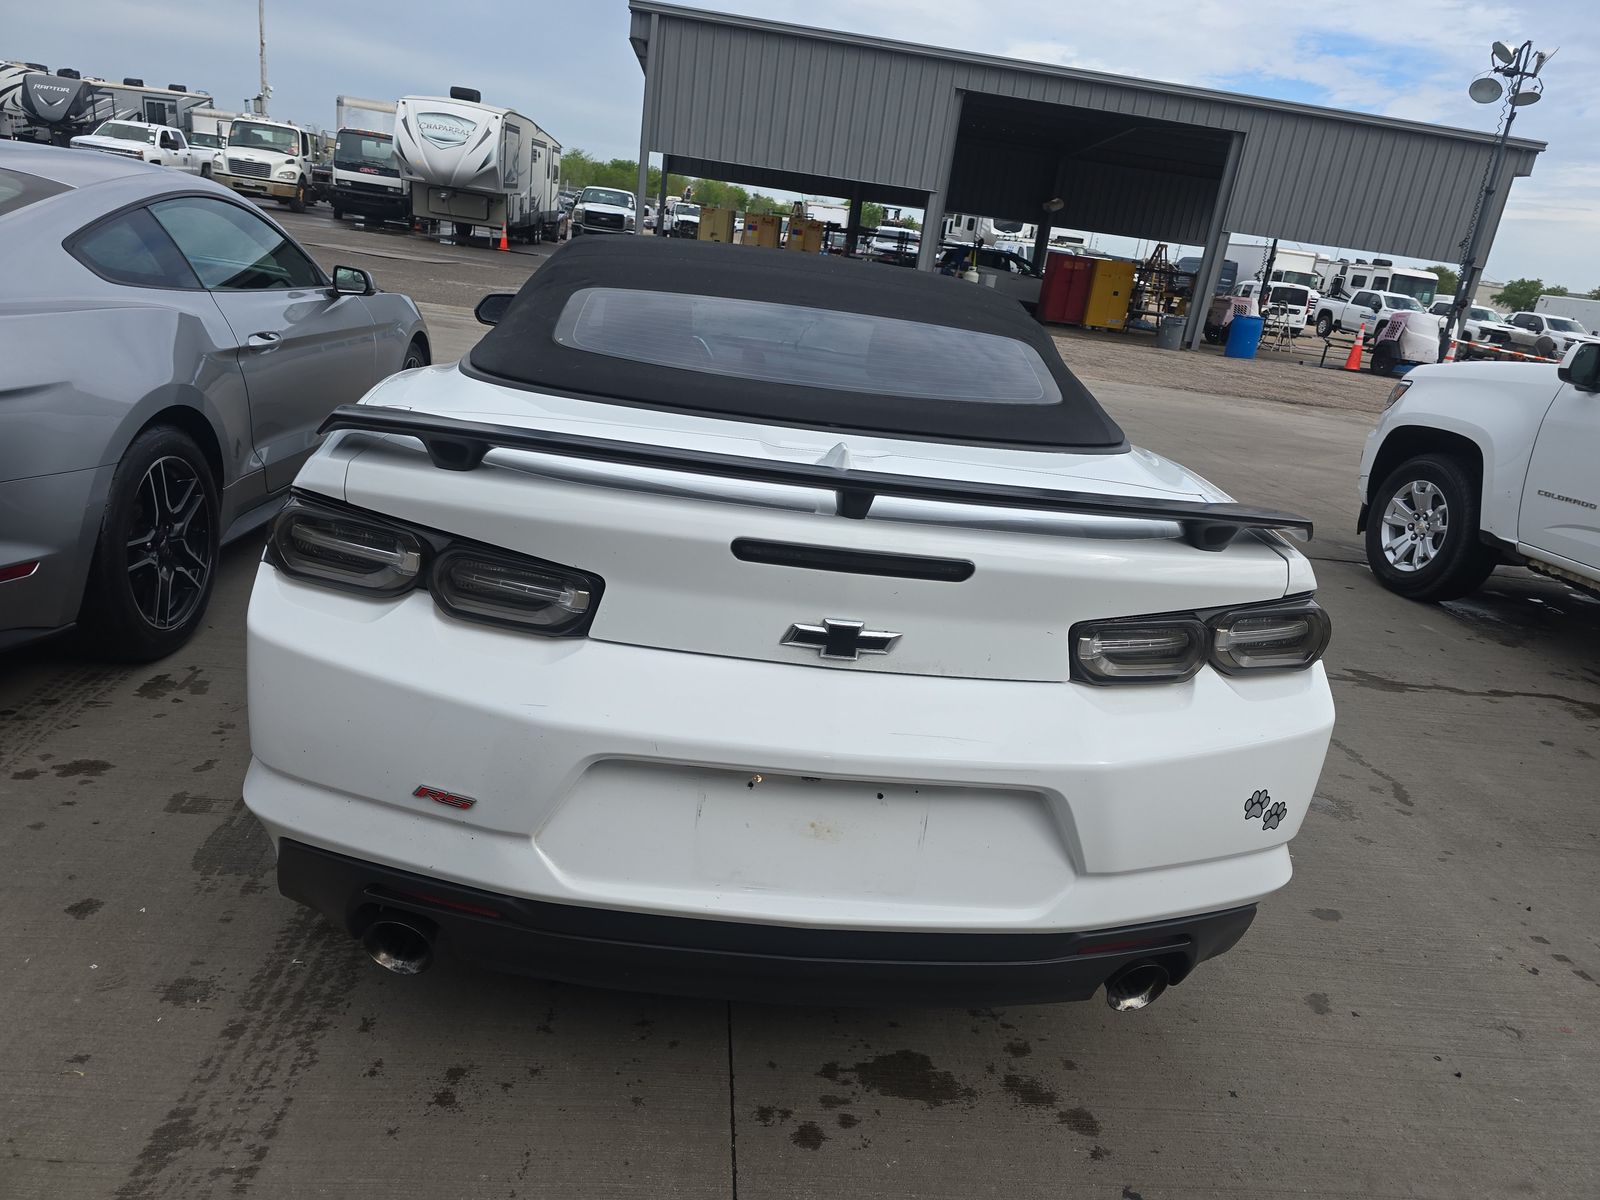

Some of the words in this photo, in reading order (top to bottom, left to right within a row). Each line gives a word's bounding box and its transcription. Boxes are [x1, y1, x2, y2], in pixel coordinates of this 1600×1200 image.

[33, 83, 71, 94] RAPTOR
[419, 121, 471, 136] CHAPARRAL
[360, 167, 380, 175] GMC
[1537, 489, 1598, 510] COLORADO
[412, 784, 477, 810] RS
